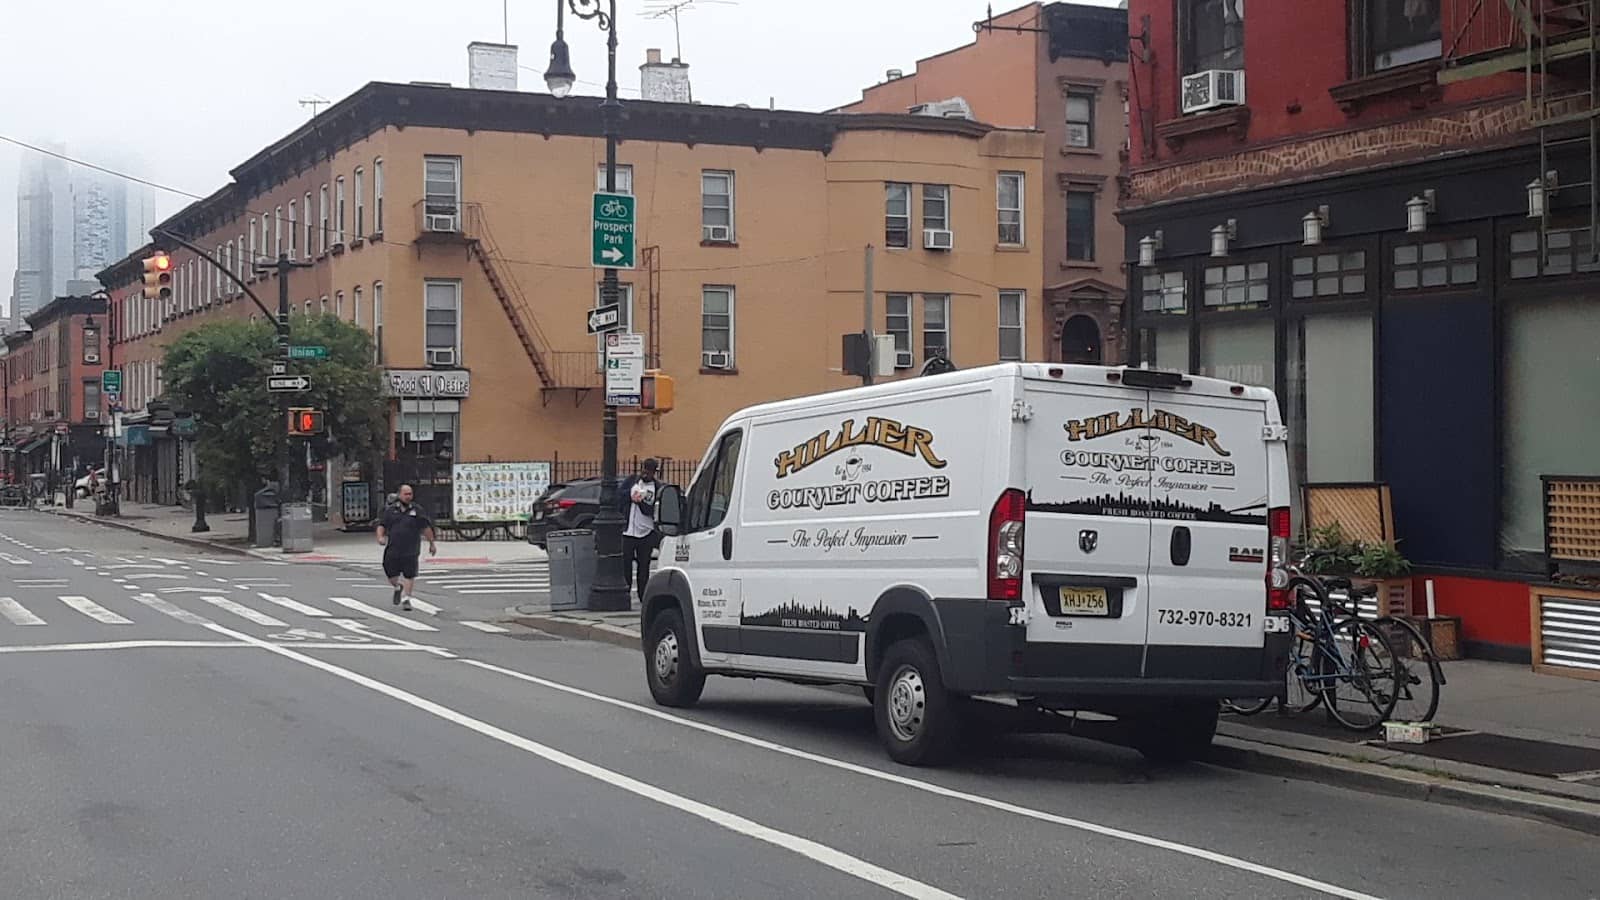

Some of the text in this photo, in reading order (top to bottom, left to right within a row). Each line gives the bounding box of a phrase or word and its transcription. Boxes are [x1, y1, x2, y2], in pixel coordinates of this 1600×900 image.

[594, 220, 633, 234] Prospect
[603, 233, 624, 244] Park
[604, 313, 616, 323] WAY
[291, 348, 315, 357] Union
[391, 375, 470, 393] Food U Desire
[1064, 408, 1231, 457] HILLIER
[775, 416, 947, 479] HILLIER
[1060, 450, 1236, 477] GOURMET COFFEE
[1089, 471, 1209, 493] The Perfect Impression
[767, 476, 951, 511] GOURMET COFFEE
[1102, 507, 1197, 521] FRESH ROASTED COFFEE
[790, 526, 908, 553] The Perfect Impression
[1229, 547, 1264, 556] RAM
[1158, 609, 1251, 628] 732-970-8321
